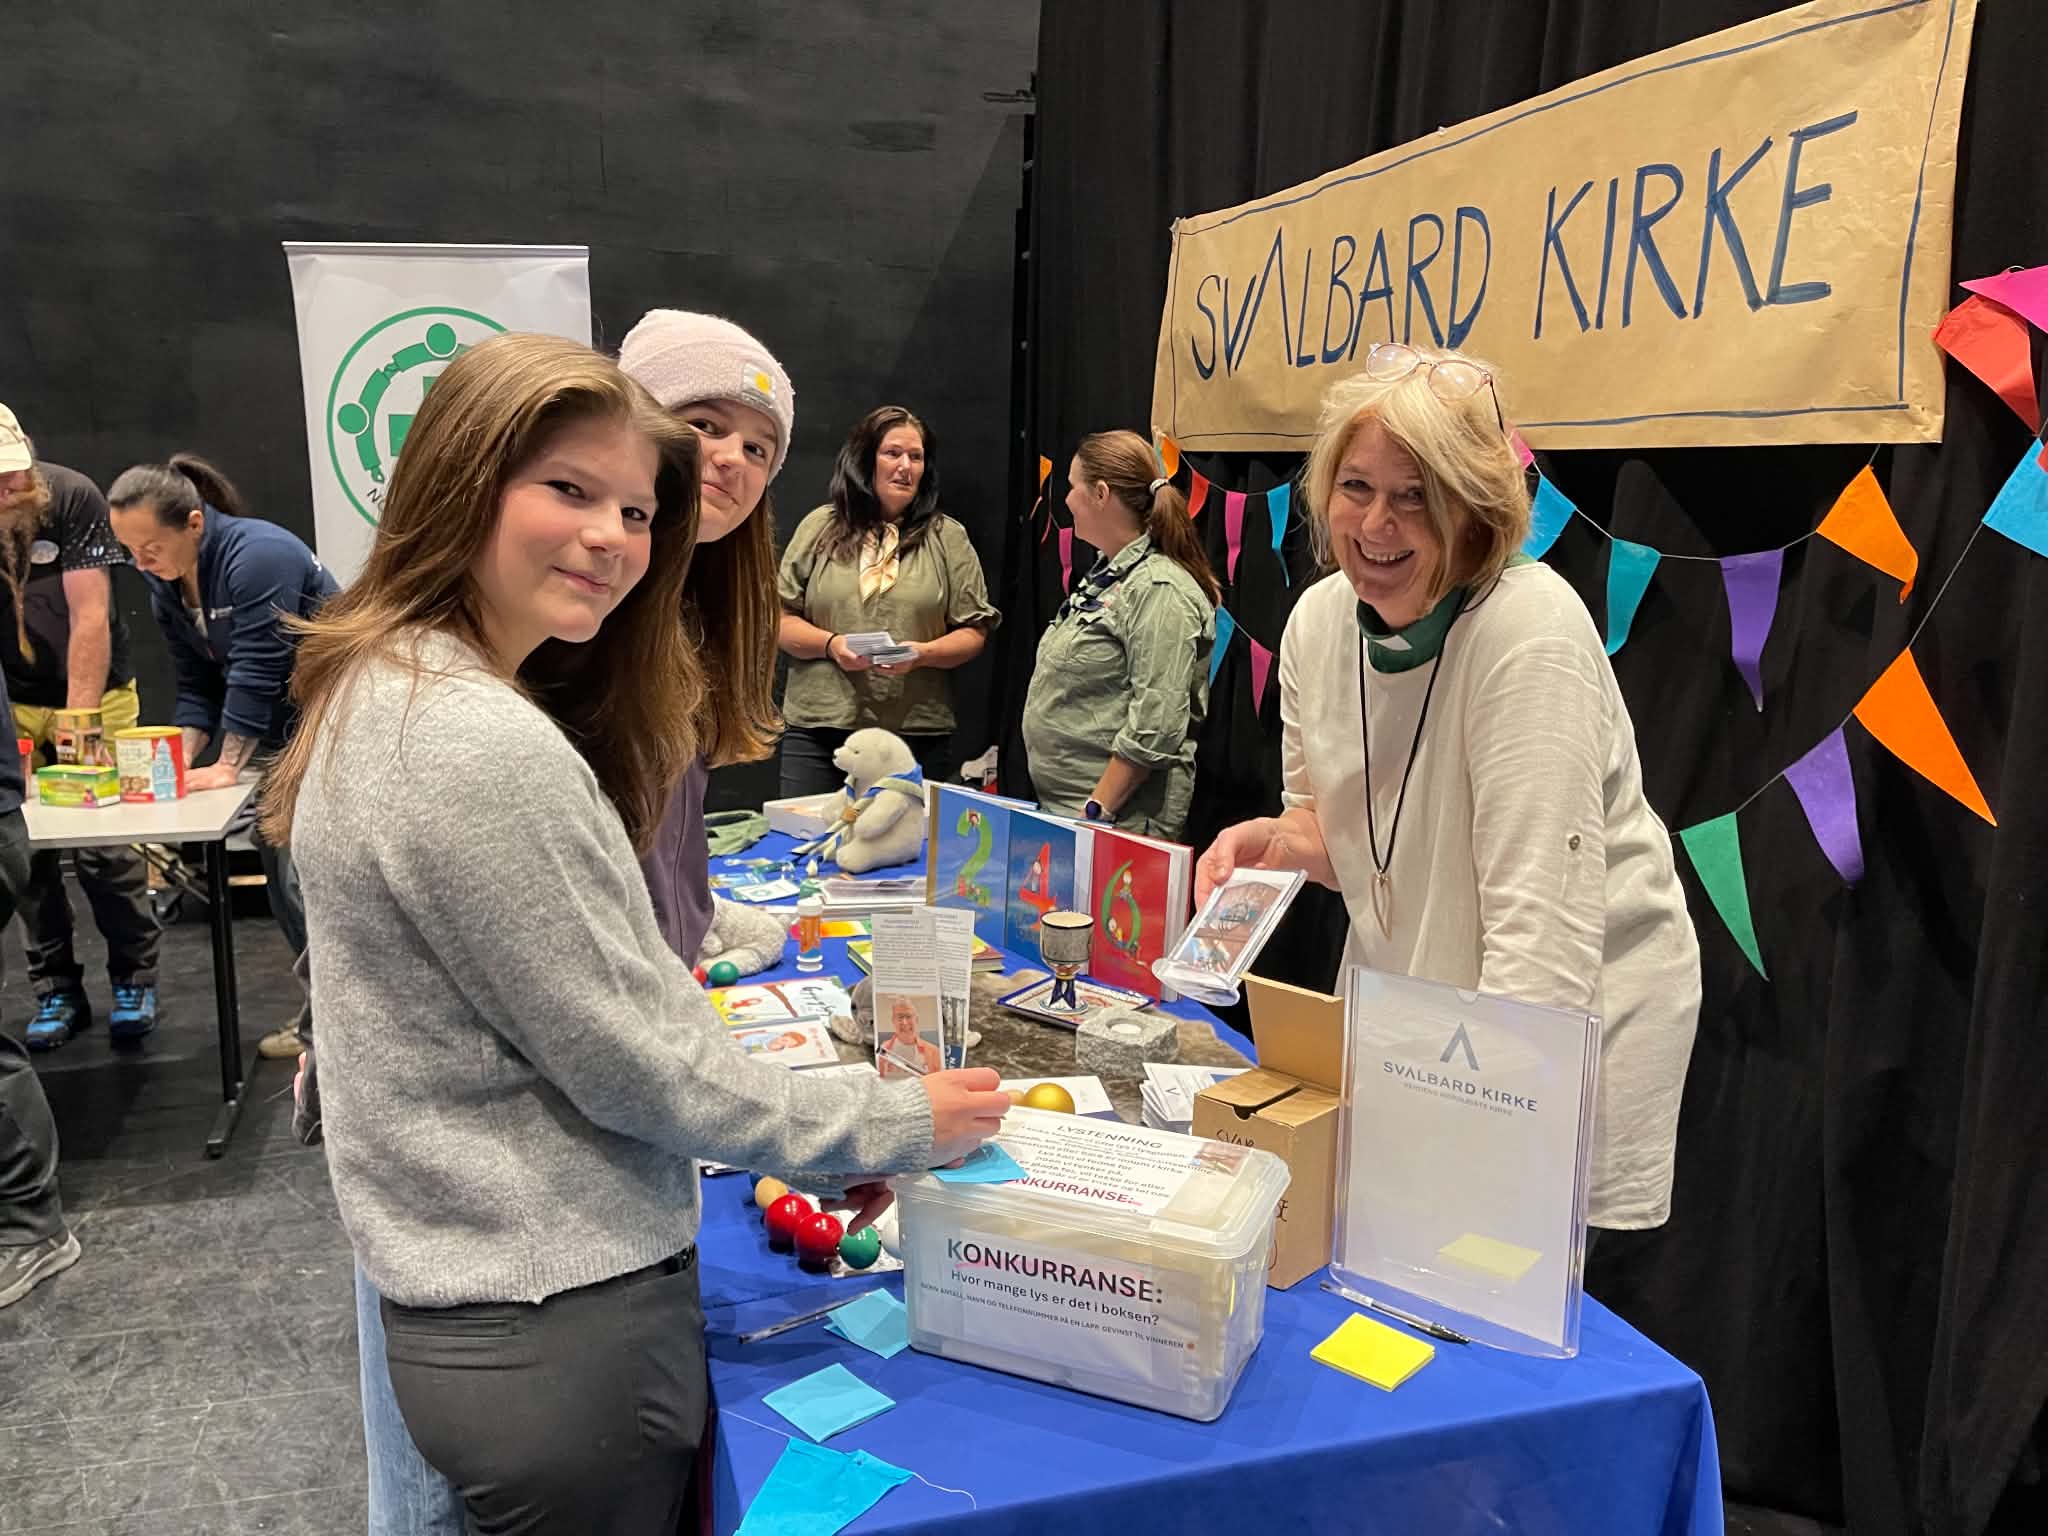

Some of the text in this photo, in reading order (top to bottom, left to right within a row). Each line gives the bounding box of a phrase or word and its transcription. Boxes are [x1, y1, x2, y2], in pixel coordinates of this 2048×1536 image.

[1192, 110, 1858, 381] SVALBARD KIRKE
[1384, 1061, 1537, 1111] SVALBARD KIRKE
[1057, 1126, 1162, 1148] LYSTENNING
[1016, 1177, 1134, 1203] NKURRANSE:
[948, 1238, 1162, 1304] KONKURRANSE:
[952, 1270, 980, 1287] Hvor
[984, 1279, 1027, 1297] mange
[1031, 1288, 1048, 1302] lys
[1052, 1294, 1063, 1305] er
[1068, 1297, 1090, 1311] det
[1101, 1304, 1160, 1326] boksen?
[967, 1294, 985, 1305] NAVN
[986, 1299, 997, 1307] OG
[998, 1302, 1058, 1321] TELEFONNUMMER
[1102, 1325, 1133, 1338] GEVINST
[1146, 1335, 1184, 1348] VINNEREN
